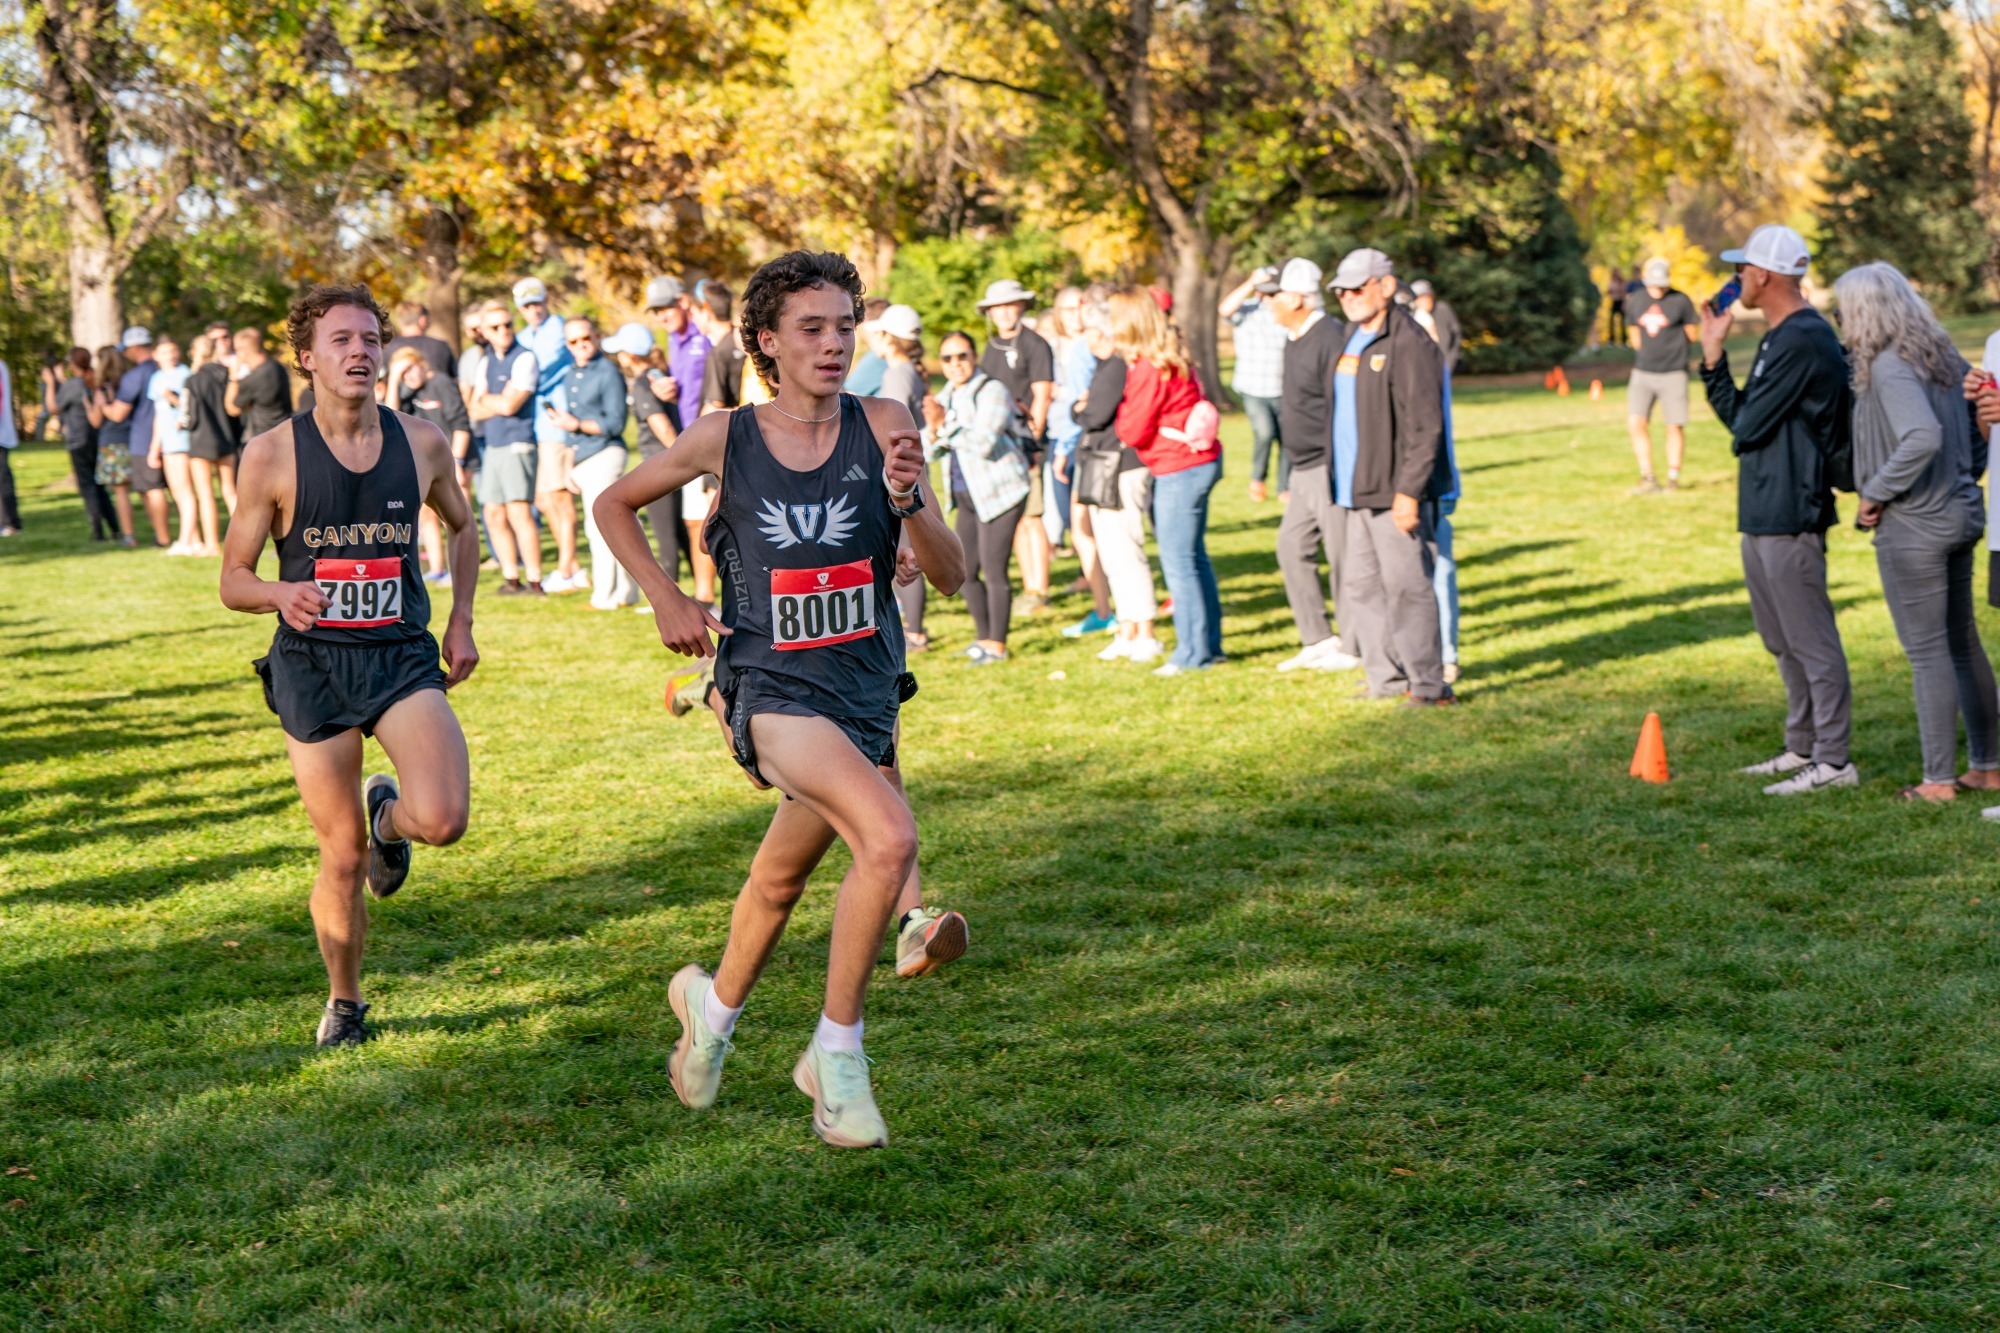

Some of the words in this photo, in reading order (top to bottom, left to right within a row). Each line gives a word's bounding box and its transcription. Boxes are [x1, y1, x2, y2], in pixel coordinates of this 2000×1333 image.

[303, 523, 411, 547] CANYON
[790, 504, 822, 540] V
[319, 579, 398, 620] 7992
[777, 587, 869, 641] 8001
